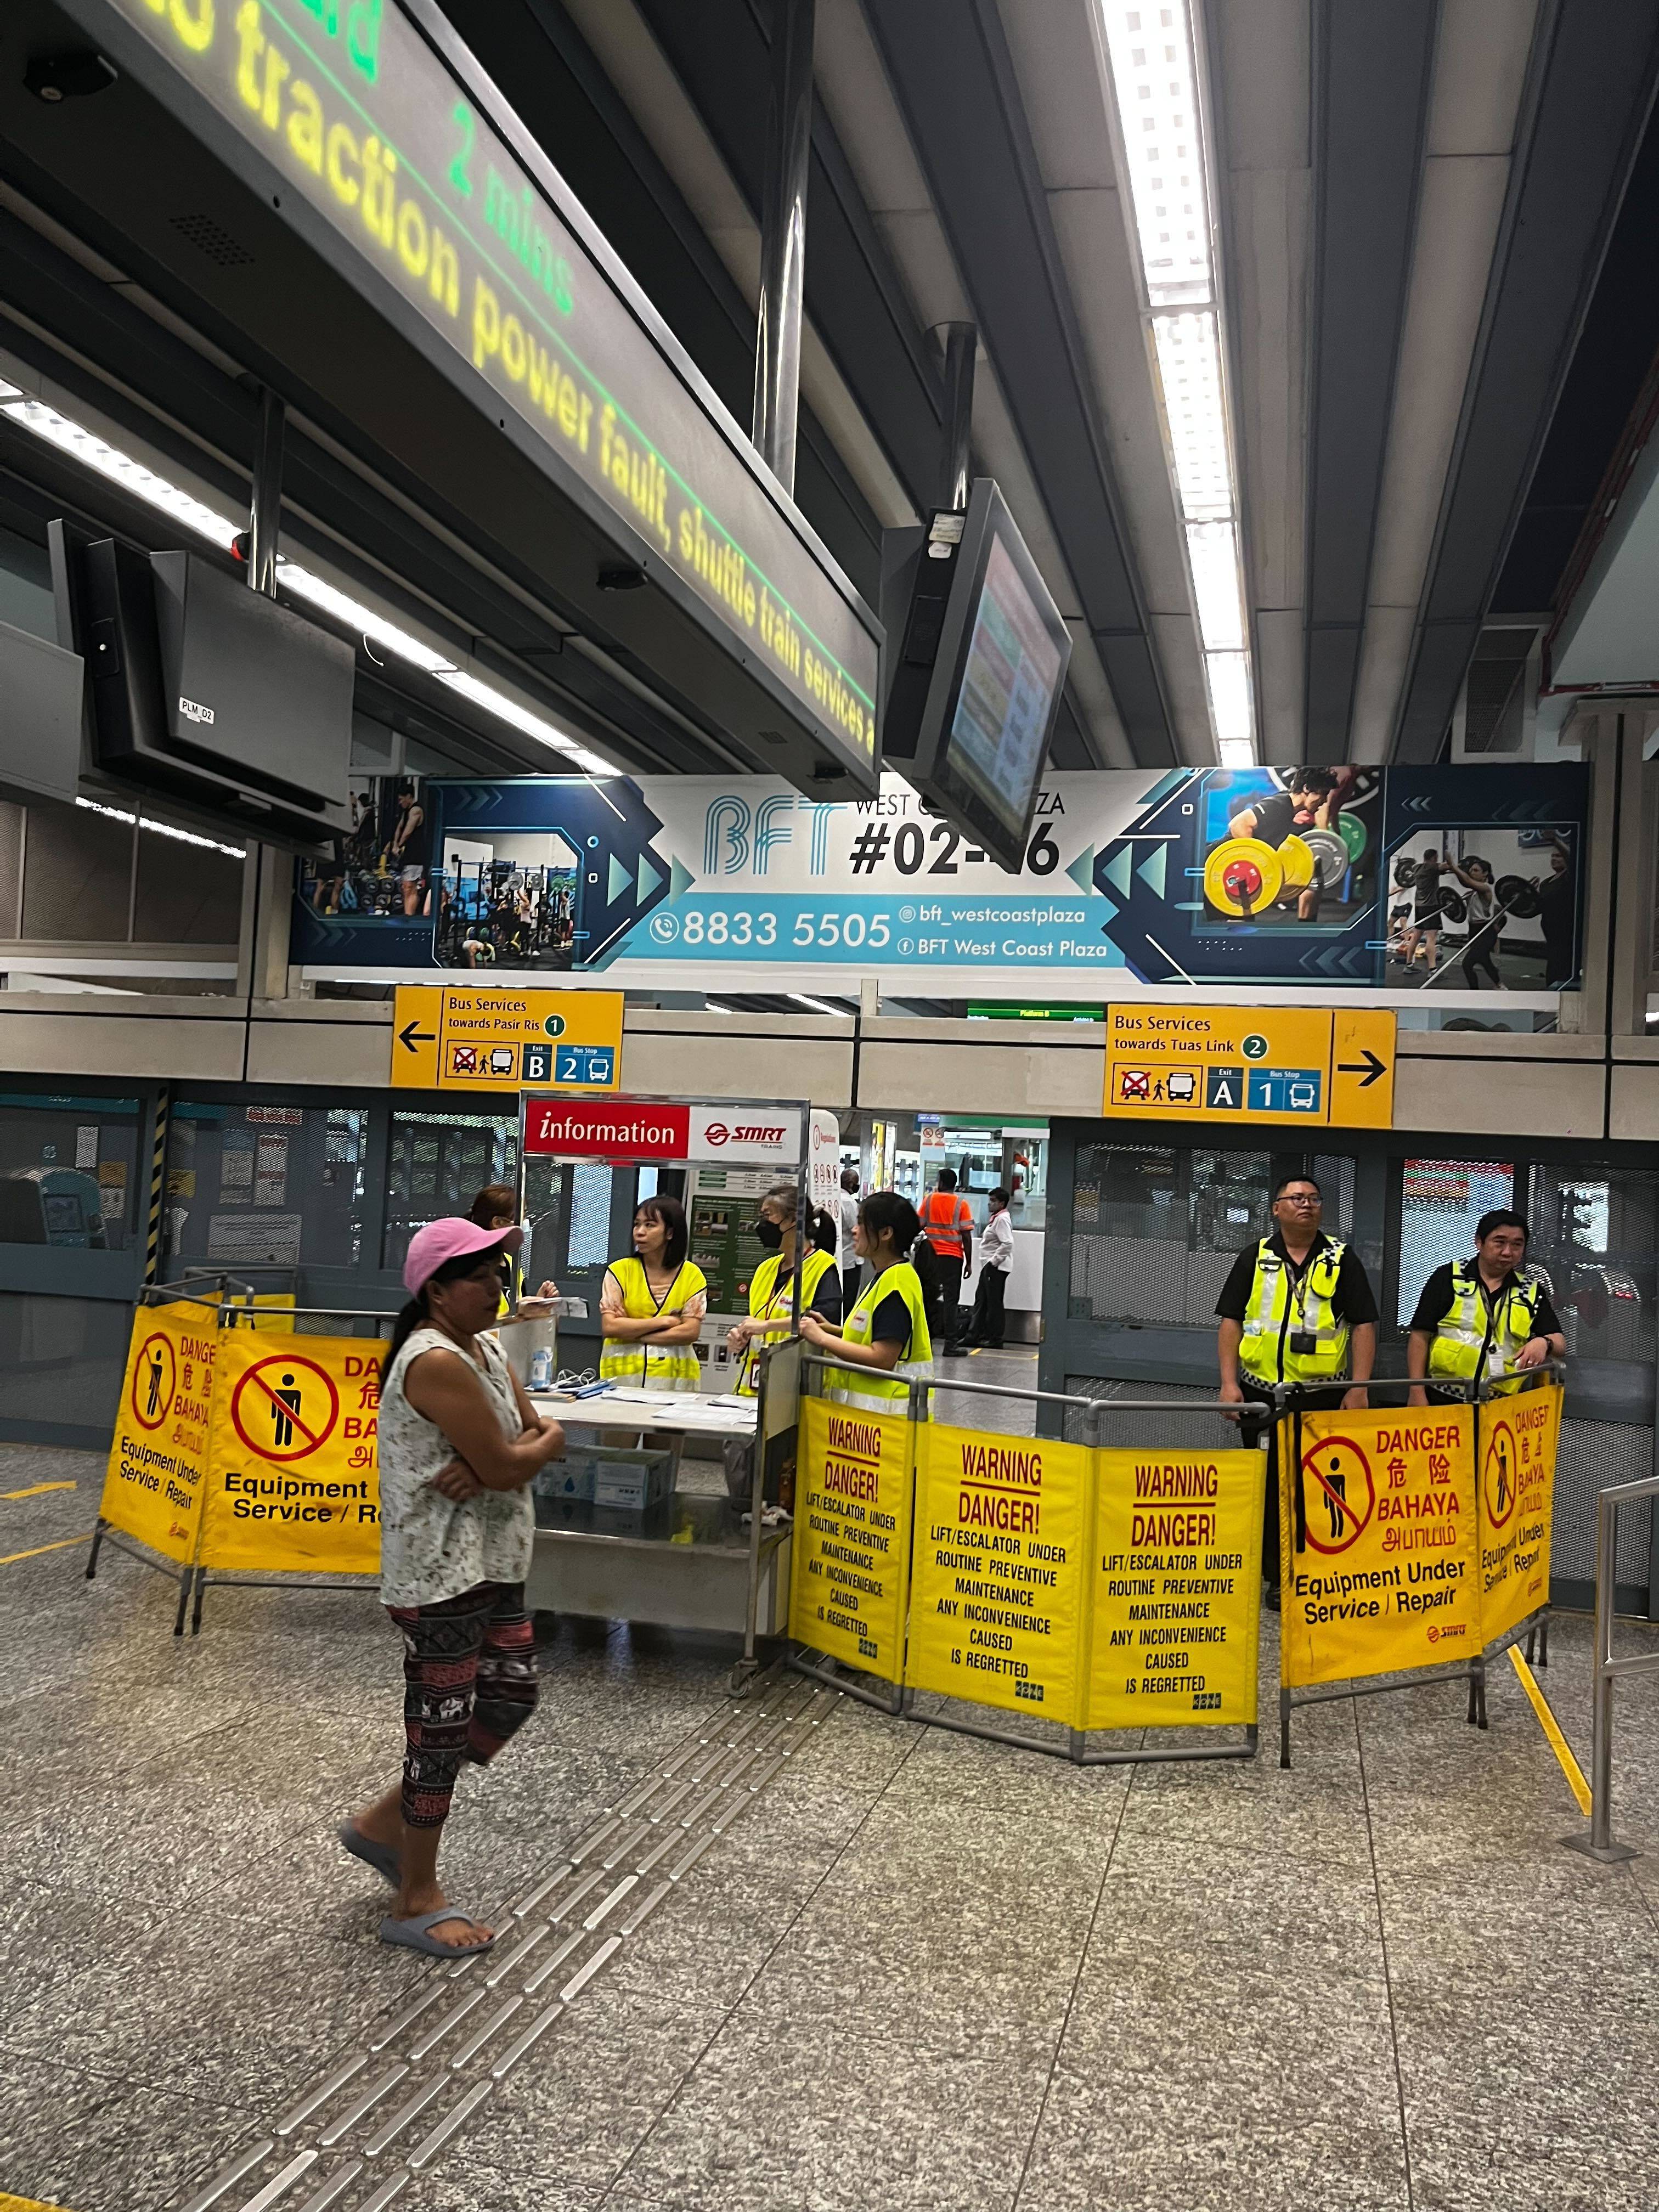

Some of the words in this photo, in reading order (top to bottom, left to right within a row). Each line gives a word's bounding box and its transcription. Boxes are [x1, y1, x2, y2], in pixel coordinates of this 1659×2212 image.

[448, 101, 475, 198] 2
[484, 163, 573, 317] mins
[235, 1, 460, 318] traction
[472, 273, 594, 454] power
[599, 402, 670, 552] fault,
[678, 505, 756, 628] shuttle
[760, 585, 800, 677] train
[804, 647, 864, 743] services
[856, 794, 911, 816] WEST
[703, 794, 848, 876] BFT
[849, 822, 1060, 876] #02-6
[683, 911, 777, 945] 8833
[792, 912, 891, 948] 5505
[919, 904, 1086, 926] bft_westcoastplaza
[918, 939, 949, 955] BFT
[952, 940, 999, 956] West
[1001, 940, 1056, 956] Coast
[1059, 940, 1108, 958] Plaza
[449, 997, 472, 1011] Bus
[476, 997, 527, 1012] Services
[449, 1018, 490, 1029] towards
[494, 1018, 520, 1030] Pasir
[524, 1020, 540, 1030] Ris
[550, 1019, 558, 1032] 1
[1115, 1015, 1142, 1029] Bus
[1148, 1015, 1211, 1031] Services
[1115, 1039, 1166, 1050] towards
[1170, 1039, 1202, 1051] Tuas
[1206, 1041, 1234, 1052] Link
[1249, 1040, 1261, 1054] 2
[529, 1056, 544, 1079] B
[562, 1057, 577, 1080] 2
[1284, 1071, 1300, 1079] Stop
[1212, 1081, 1234, 1105] A
[1259, 1083, 1272, 1107] 1
[539, 1111, 675, 1145] information
[731, 1126, 787, 1141] SMRT
[180, 1335, 217, 1365] DANGE
[828, 1416, 882, 1457] WARNING
[1376, 1425, 1461, 1453] DANGER
[121, 1435, 177, 1474] Equipment
[961, 1443, 1042, 1486] WARNING
[120, 1460, 160, 1492] Service
[225, 1472, 368, 1499] Equipment
[825, 1461, 879, 1503] DANGER!
[1134, 1464, 1218, 1498] WARNING
[233, 1498, 332, 1523] Service
[806, 1491, 866, 1523] LIFT/ESCALATOR
[870, 1510, 896, 1531] UNDER
[958, 1492, 1040, 1534] DANGER!
[1377, 1492, 1460, 1521] BAHAYA
[809, 1514, 840, 1538] ROUTINE
[843, 1523, 889, 1553] PREVENTIVE
[930, 1525, 1020, 1555] LIFT/ESCALATOR
[1028, 1542, 1066, 1564] UNDER
[1131, 1513, 1216, 1547] DANGER!
[821, 1540, 873, 1571] MAINTENANCE
[935, 1550, 981, 1572] ROUTINE
[989, 1561, 1057, 1587] PREVENTIVE
[1102, 1554, 1197, 1572] LIFT/ESCALATOR
[1205, 1553, 1243, 1570] UNDER
[809, 1558, 823, 1576] ANY
[826, 1565, 883, 1598] INCONVENIENCE
[955, 1577, 1034, 1607] MAINTENANCE
[1108, 1578, 1155, 1596] ROUTINE
[1162, 1578, 1234, 1595] PREVENTIVE
[1295, 1567, 1402, 1599] Equipment
[1407, 1558, 1466, 1583] Under
[830, 1588, 859, 1611] CAUSED
[1128, 1601, 1210, 1621] MAINTENANCE
[1304, 1598, 1380, 1626] Service
[1396, 1586, 1457, 1614] Repair
[817, 1606, 825, 1621] IS
[827, 1611, 867, 1637] REGRETTED
[936, 1598, 958, 1616] ANY
[964, 1603, 1051, 1635] INCONVENIENCE
[969, 1628, 1013, 1651] CAUSED
[1110, 1629, 1133, 1646] ANY
[1138, 1626, 1227, 1645] INCONVENIENCE
[951, 1649, 961, 1664] IS
[966, 1653, 1029, 1679] REGRETTED
[1145, 1651, 1189, 1670] CAUSED
[1125, 1677, 1137, 1694] IS
[1141, 1674, 1206, 1694] REGRETTED
